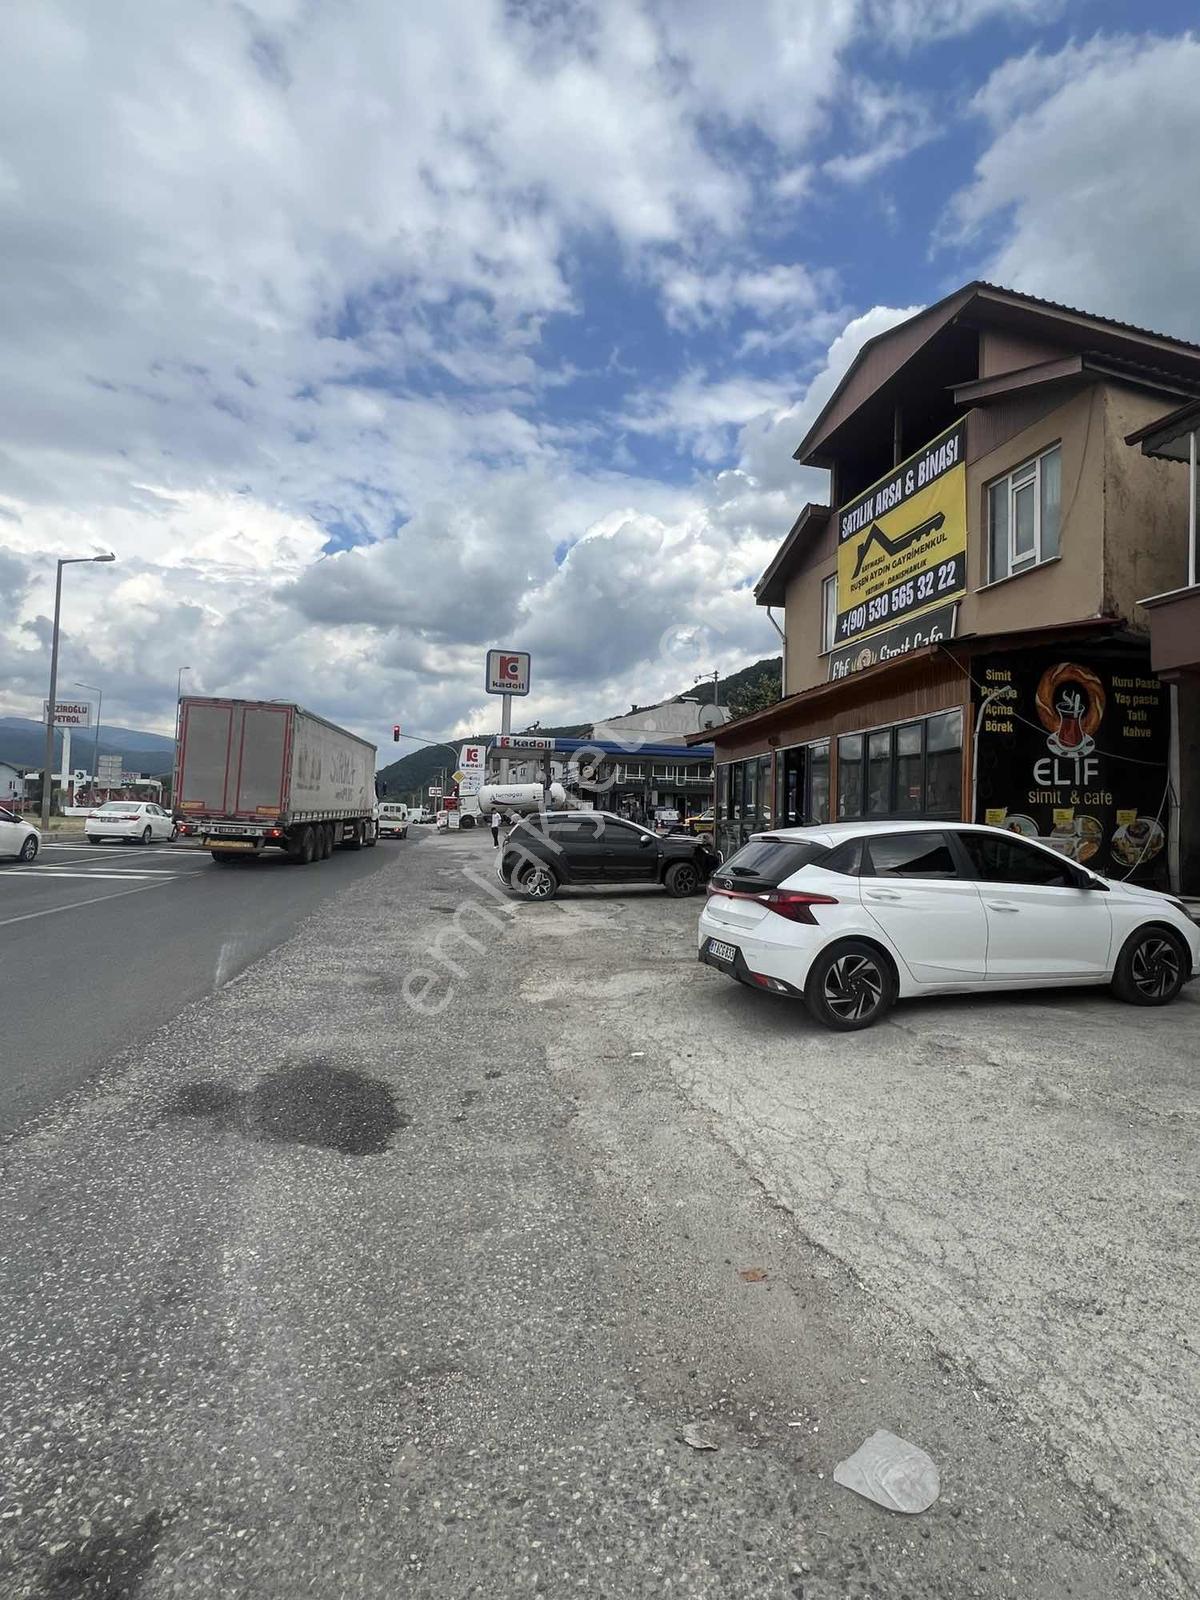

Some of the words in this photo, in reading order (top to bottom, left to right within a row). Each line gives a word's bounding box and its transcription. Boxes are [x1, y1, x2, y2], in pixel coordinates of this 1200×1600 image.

[841, 498, 874, 538] SATILIK
[875, 478, 902, 516] ARSA
[904, 469, 914, 495] &
[917, 435, 959, 487] BİNASI
[869, 563, 891, 582] AYDIN
[891, 533, 948, 569] GAYRİMENKUL
[841, 604, 867, 636] +(90)
[868, 594, 889, 622] 530
[891, 581, 914, 612] 565
[917, 571, 934, 600] 32
[938, 560, 956, 591] 22
[985, 669, 1012, 681] Simit
[1112, 676, 1134, 689] Kuru
[46, 704, 88, 714] VZİROĞLU
[985, 703, 1013, 716] Açma
[985, 720, 1013, 733] Börek
[1123, 726, 1152, 737] Kahve
[1028, 788, 1062, 804] simit
[1070, 790, 1080, 804] &
[1084, 790, 1113, 805] cafe
